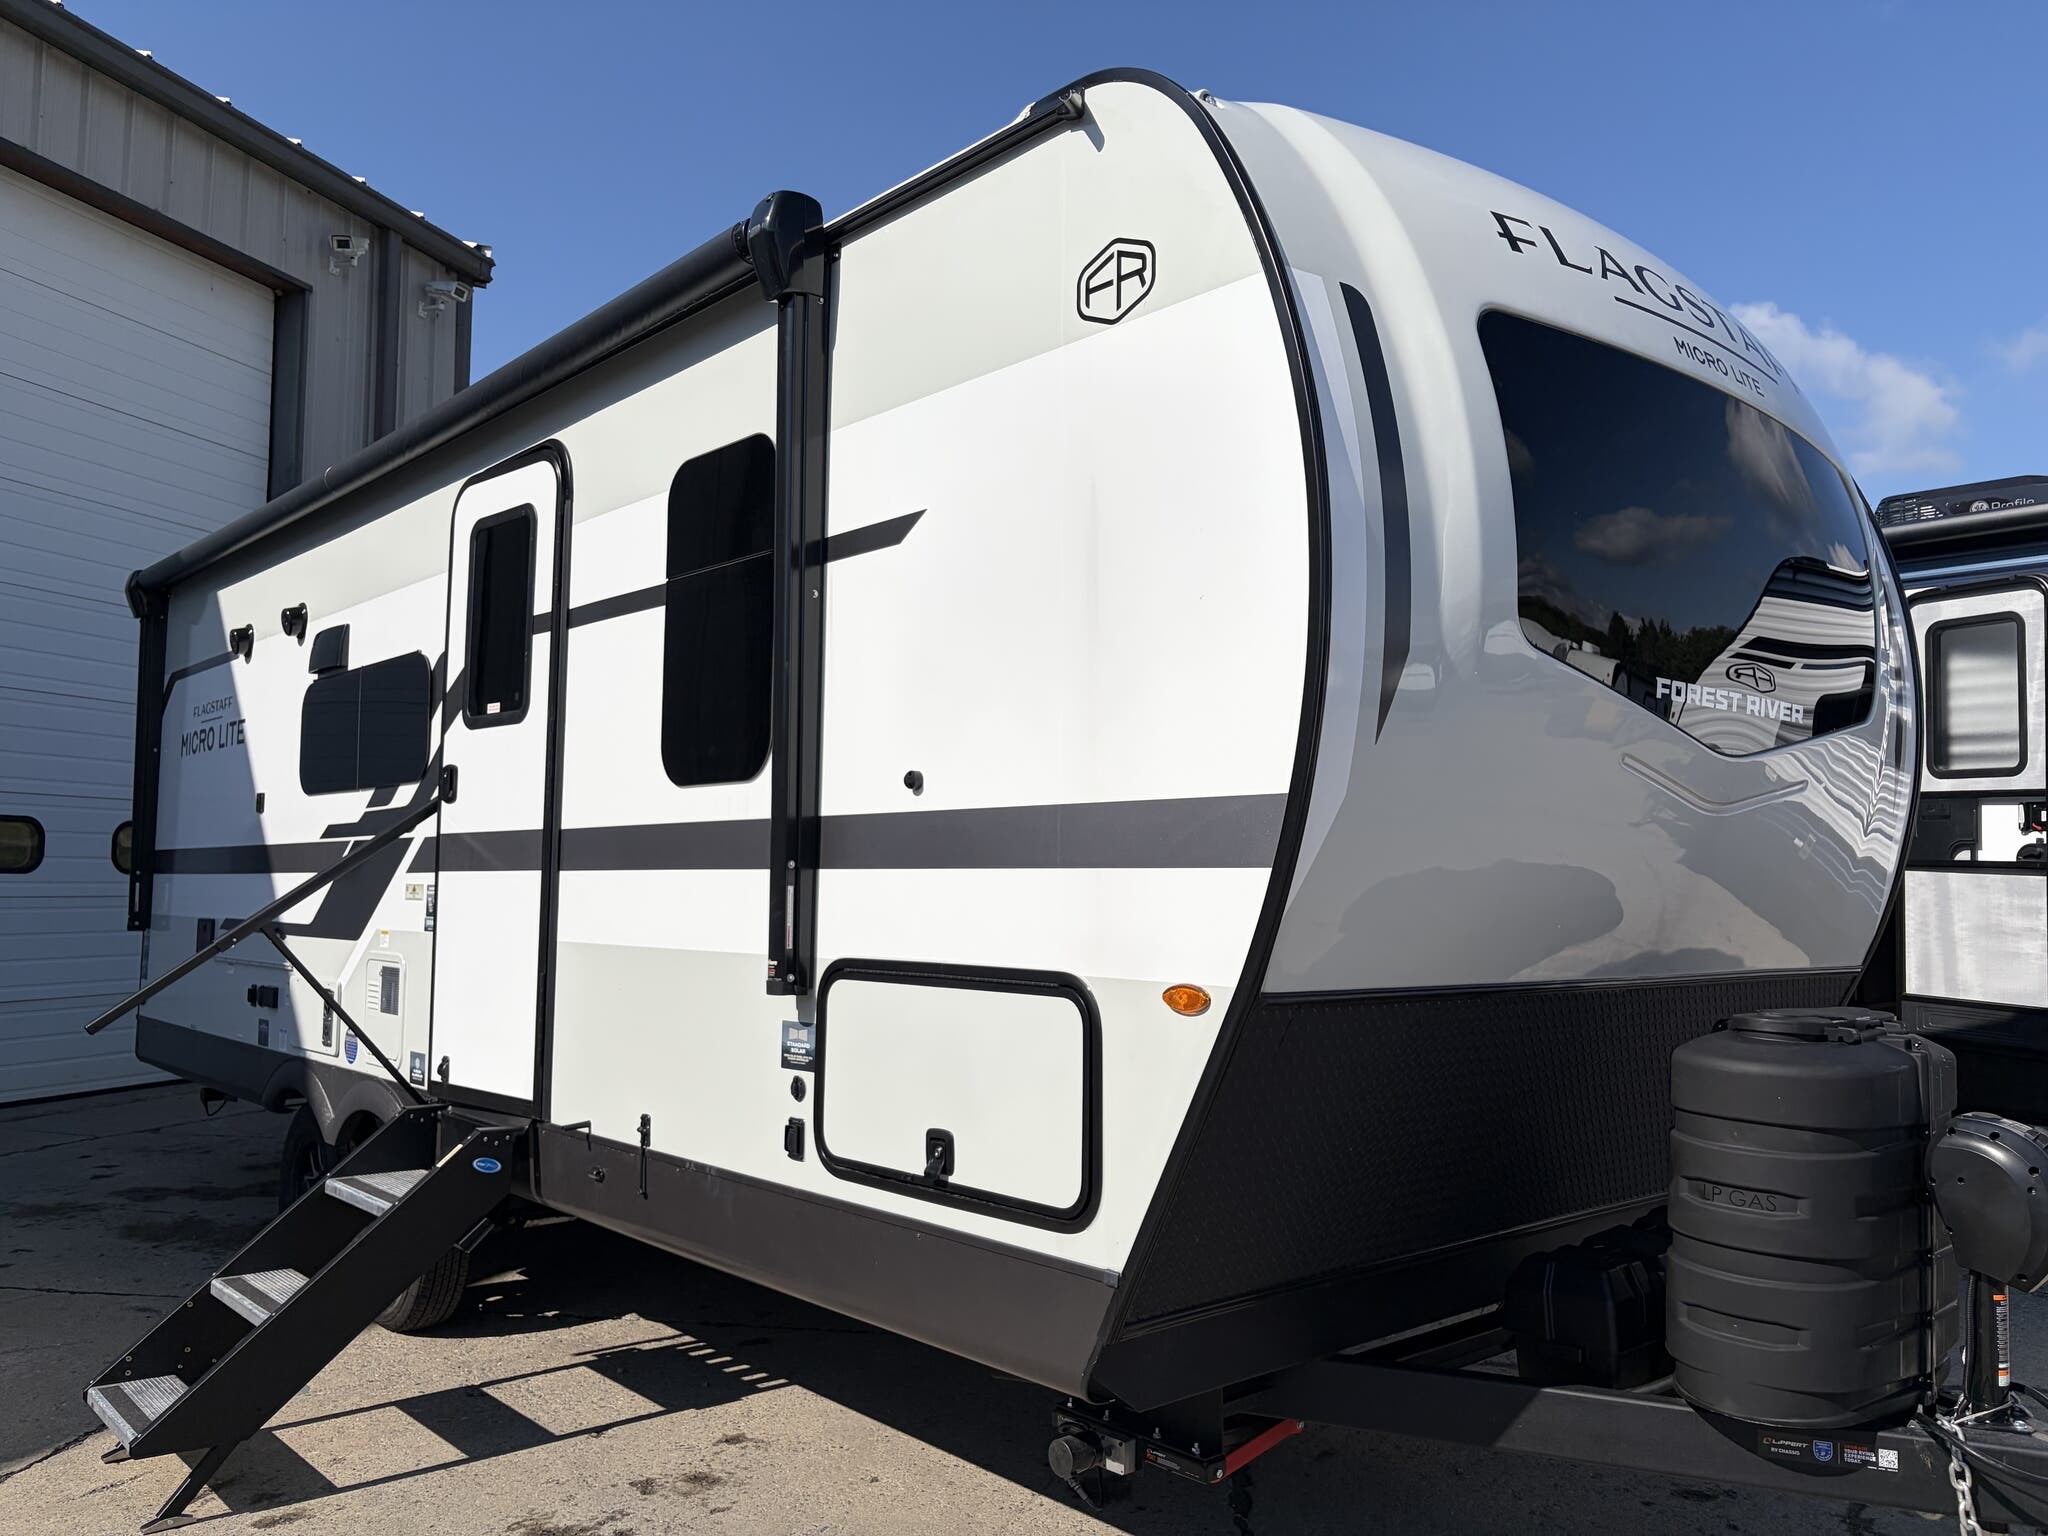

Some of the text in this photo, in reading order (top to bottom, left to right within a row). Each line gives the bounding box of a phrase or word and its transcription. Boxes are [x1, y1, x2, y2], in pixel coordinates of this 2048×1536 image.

[1673, 336, 1765, 398] MICRO LITE
[193, 696, 233, 717] FLAGSTAFF
[1655, 676, 1804, 724] FOREST RIVER
[181, 718, 246, 758] MICRO LITE
[1703, 1183, 1777, 1213] LP GAS
